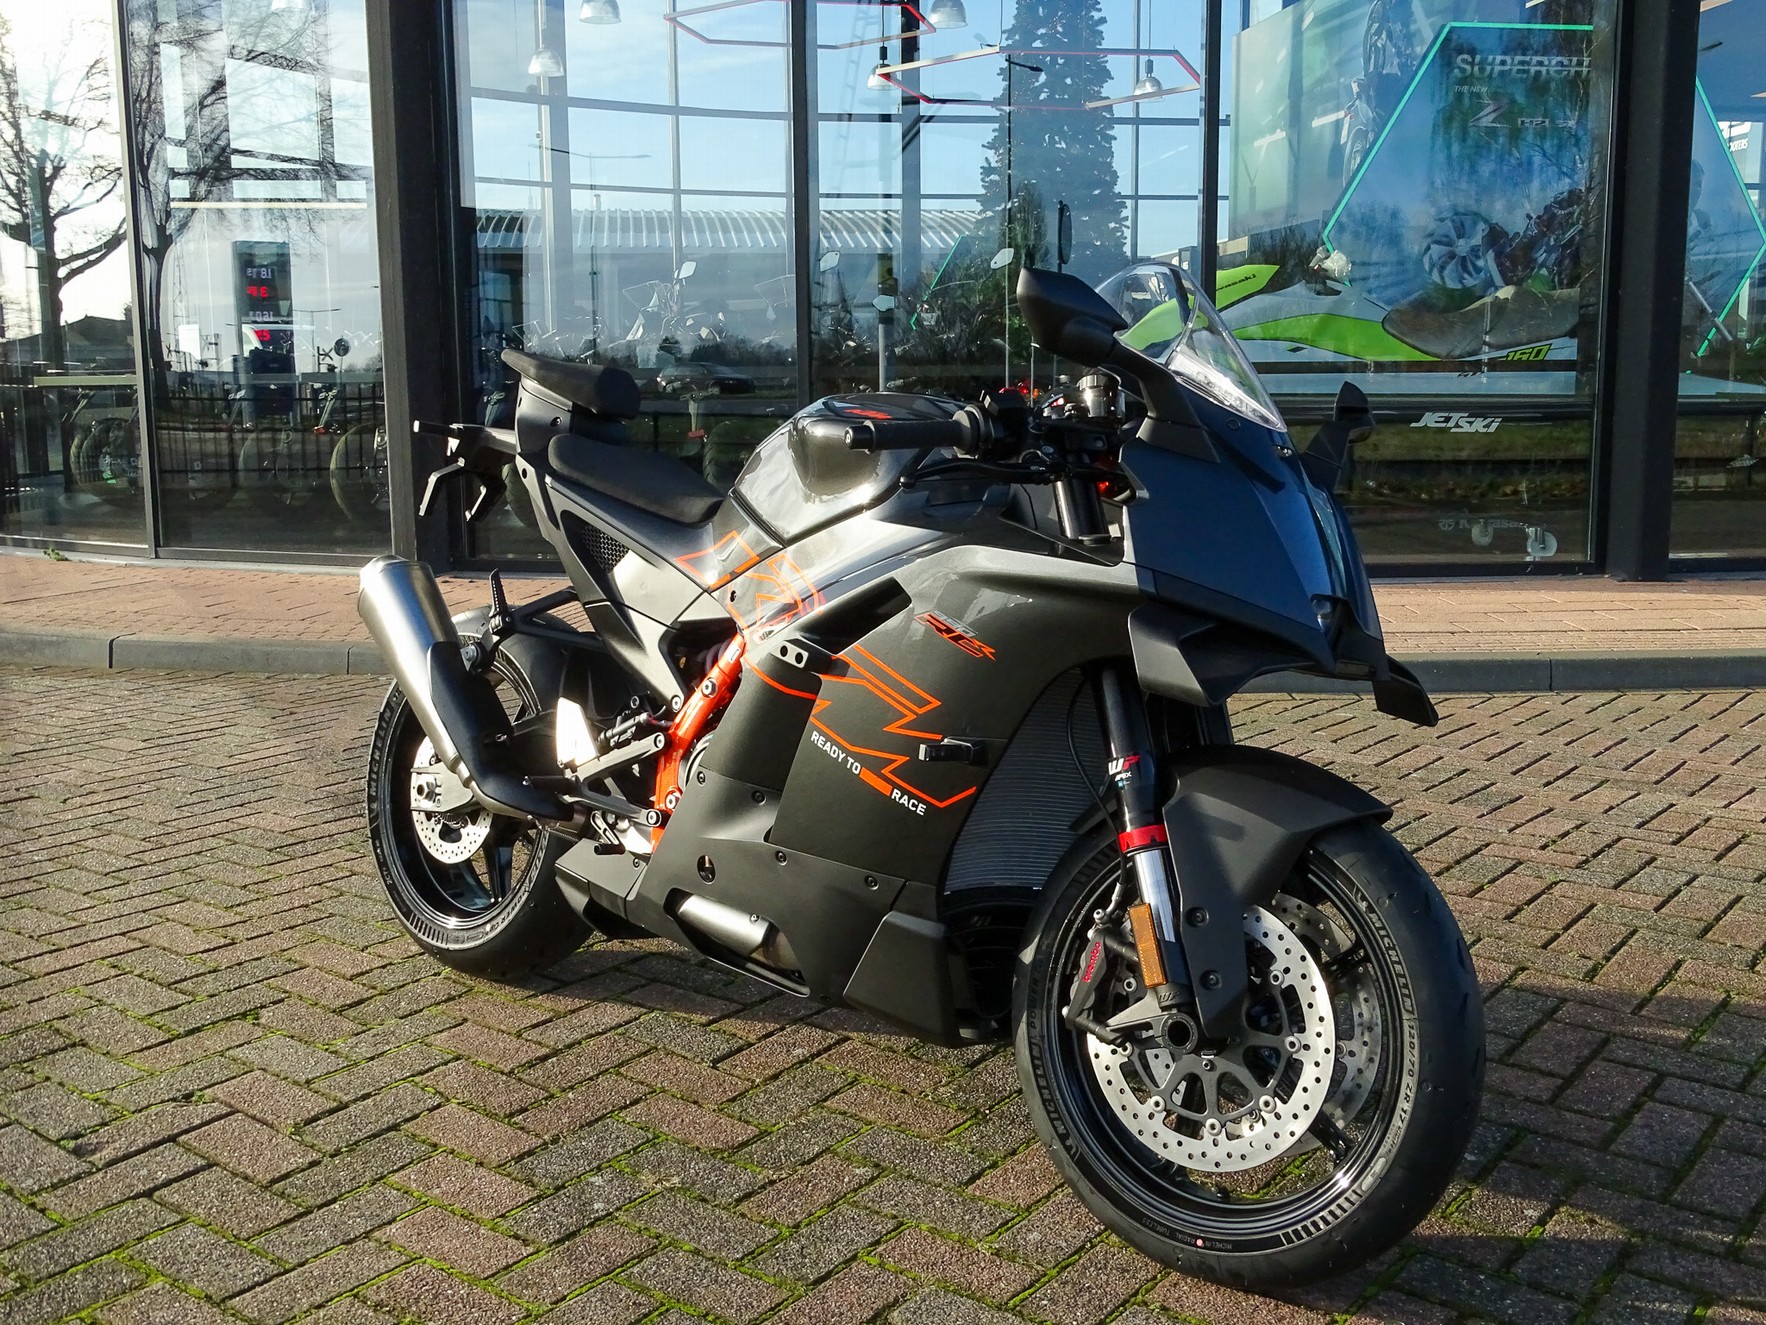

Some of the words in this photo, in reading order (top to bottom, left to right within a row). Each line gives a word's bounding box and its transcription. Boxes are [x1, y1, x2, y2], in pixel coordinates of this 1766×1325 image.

[810, 730, 846, 763] READY
[846, 756, 861, 775] TO
[891, 788, 927, 816] RACE
[1082, 941, 1102, 983] brembo
[1368, 912, 1414, 1012] MICHELIN
[1407, 1024, 1417, 1078] 120/70
[1398, 1107, 1408, 1125] 17
[1403, 1081, 1413, 1104] ZR
